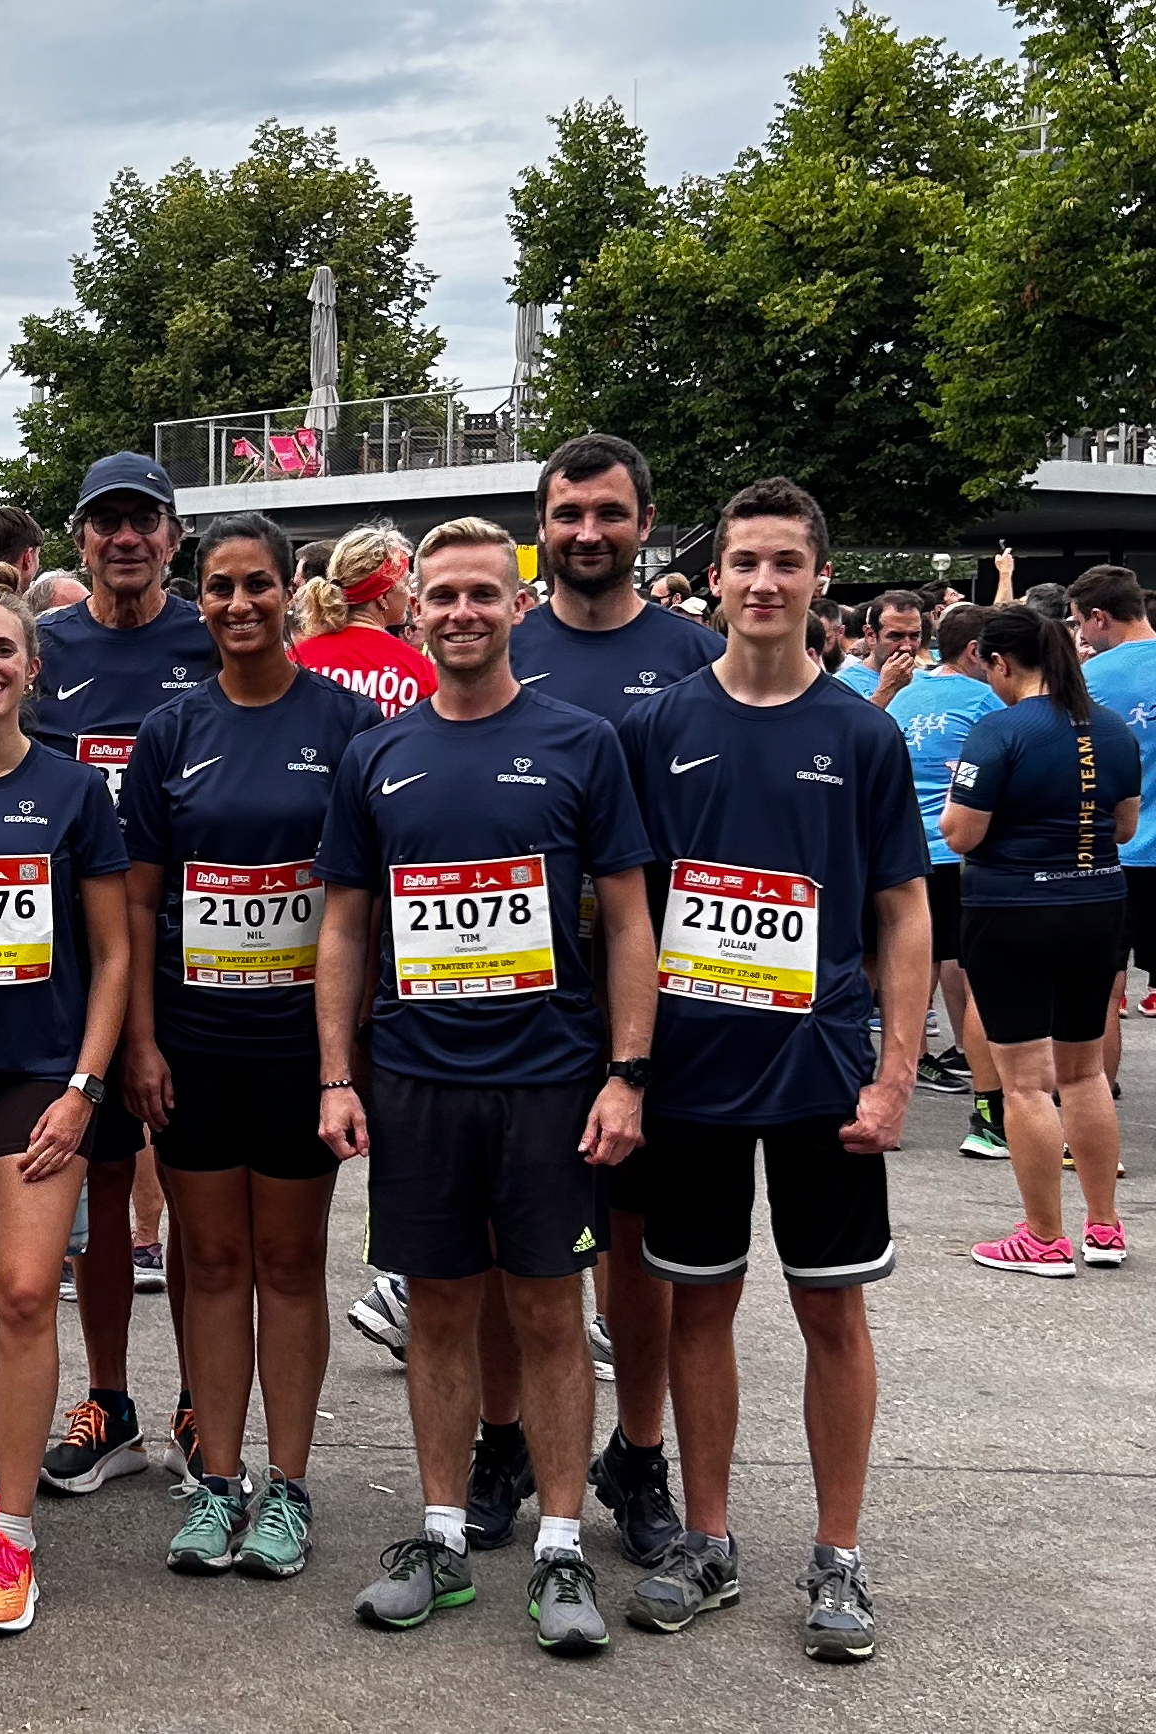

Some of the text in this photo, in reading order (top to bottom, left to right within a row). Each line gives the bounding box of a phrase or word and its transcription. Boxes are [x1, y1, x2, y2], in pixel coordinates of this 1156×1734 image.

[287, 762, 329, 773] GEOVISION
[1077, 736, 1097, 793] TEAM
[497, 774, 547, 785] GEOVISION
[796, 771, 845, 785] GEOVISION
[4, 815, 48, 826] GEOVISION
[1079, 801, 1096, 833] THE
[1077, 834, 1096, 870] JOIN
[199, 894, 311, 926] 21070
[408, 894, 531, 931] 21078
[682, 897, 803, 942] 21080
[247, 931, 264, 939] NIL
[459, 933, 480, 943] TIM
[718, 937, 756, 951] JULIAN
[218, 955, 258, 963] STARTZEIT
[432, 962, 473, 970] STARTZEIT
[694, 963, 735, 976] STARTZEIT
